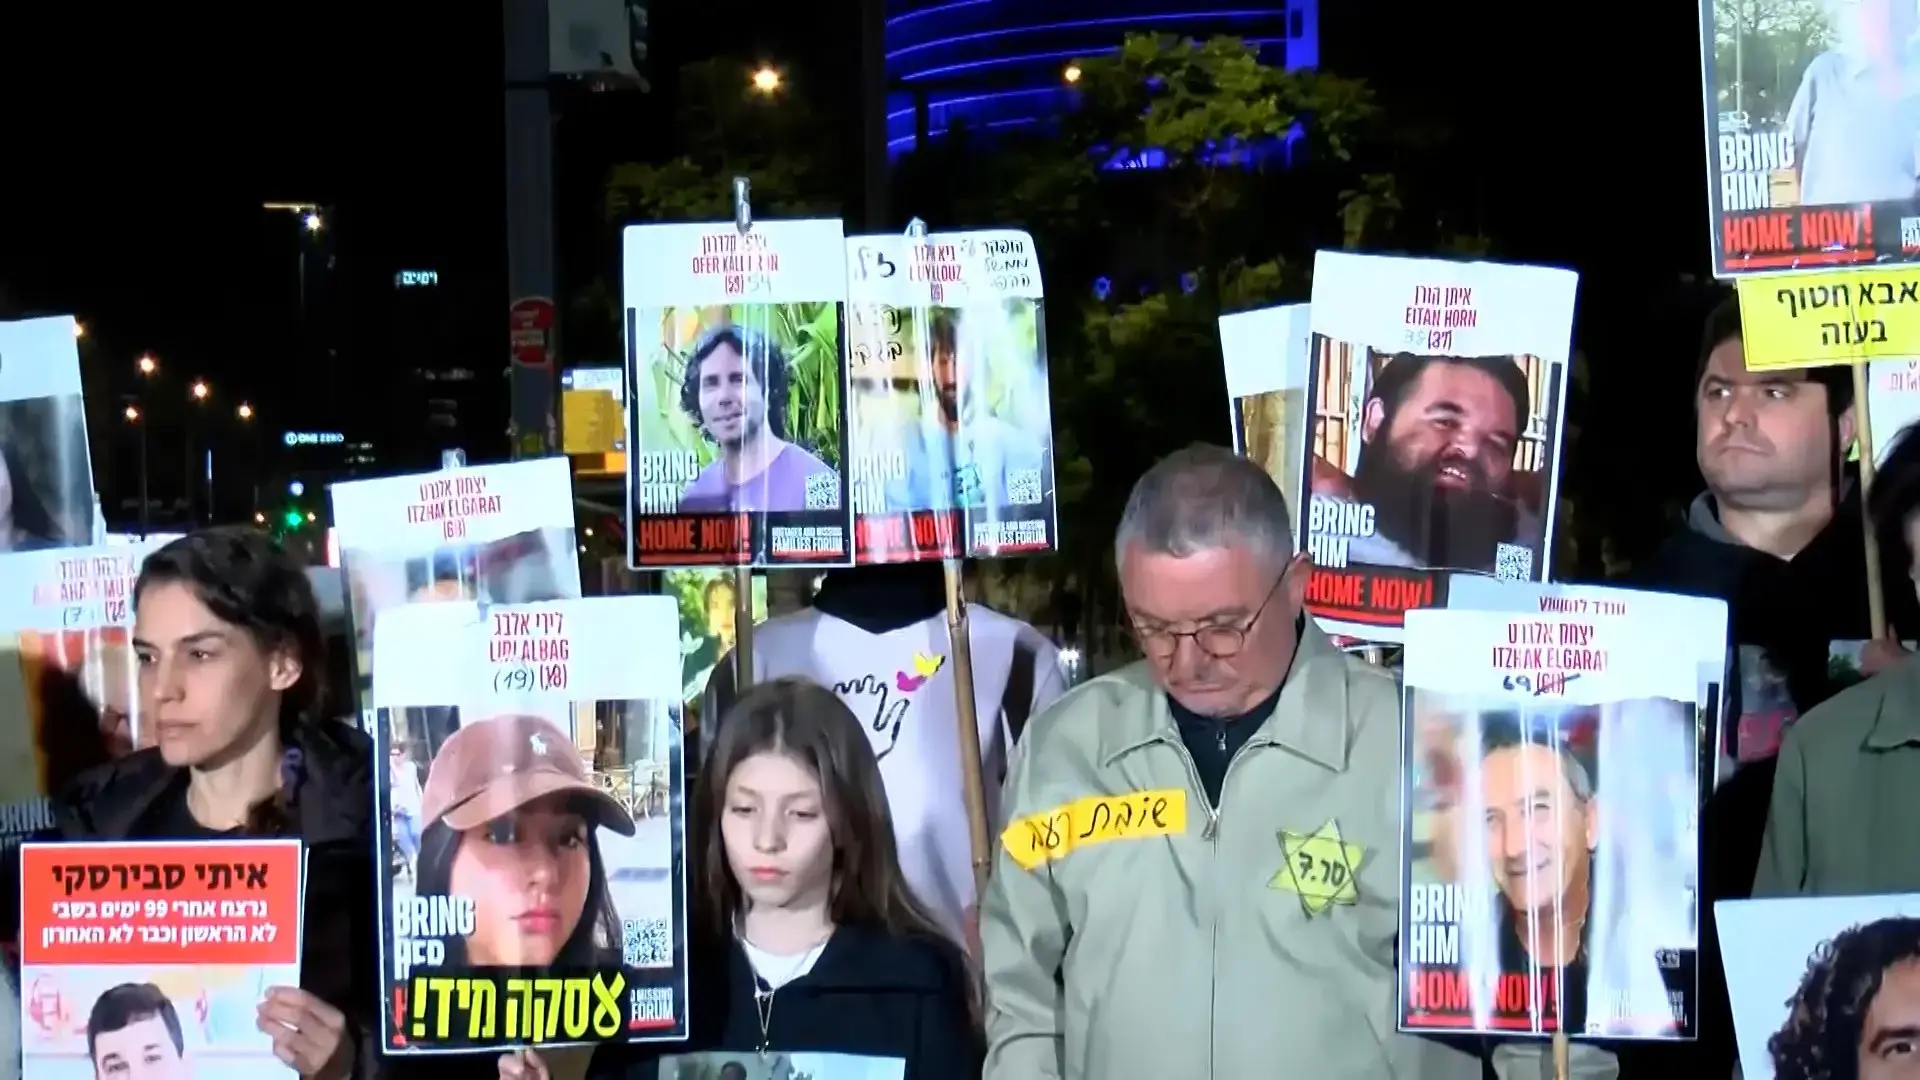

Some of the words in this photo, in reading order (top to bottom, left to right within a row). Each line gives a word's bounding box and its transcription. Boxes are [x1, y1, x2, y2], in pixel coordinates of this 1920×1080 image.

[1719, 132, 1795, 172] BRING
[1721, 171, 1771, 212] HIM
[1723, 213, 1795, 253] HOME
[1801, 202, 1874, 248] NOW!
[692, 255, 720, 274] OFER
[1415, 285, 1441, 306] הורן
[1445, 286, 1471, 308] איתן
[1777, 284, 1850, 318] חטוף
[1859, 281, 1919, 307] אבא
[1405, 307, 1441, 326] EITAN
[1444, 308, 1477, 328] HORN
[1821, 319, 1888, 346] בעזה
[641, 451, 700, 483] BRING
[407, 500, 445, 523] ITZHAK
[448, 495, 501, 517] ELGARAT
[640, 482, 679, 514] HIM
[1309, 500, 1376, 537] BRING
[640, 518, 697, 550] HOME
[1308, 535, 1349, 568] HIM
[1306, 572, 1365, 606] HOME
[494, 612, 530, 636] אלבג
[537, 612, 563, 635] לירי
[1560, 623, 1594, 646] יצחק
[521, 639, 569, 661] ALBAG
[1493, 647, 1543, 669] ITZHAK
[493, 668, 535, 694] (19)
[1503, 675, 1532, 692] 69
[52, 864, 186, 896] סבירסקי
[194, 862, 268, 890] איתי
[1298, 851, 1346, 887] 7.10
[52, 901, 98, 919] בשבי
[101, 900, 141, 919] ימים
[143, 899, 169, 919] 99
[172, 900, 216, 918] אחרי
[220, 900, 268, 918] נרצח
[393, 895, 476, 938] BRING
[42, 925, 105, 948] האחרון
[107, 922, 135, 943] לא
[137, 925, 177, 943] וכבר
[181, 924, 247, 948] הראשון
[250, 922, 277, 943] לא
[1409, 924, 1459, 964] HIM
[412, 977, 498, 1040] מיד!
[505, 972, 626, 1043] עסקה
[631, 1000, 674, 1021] FORUM
